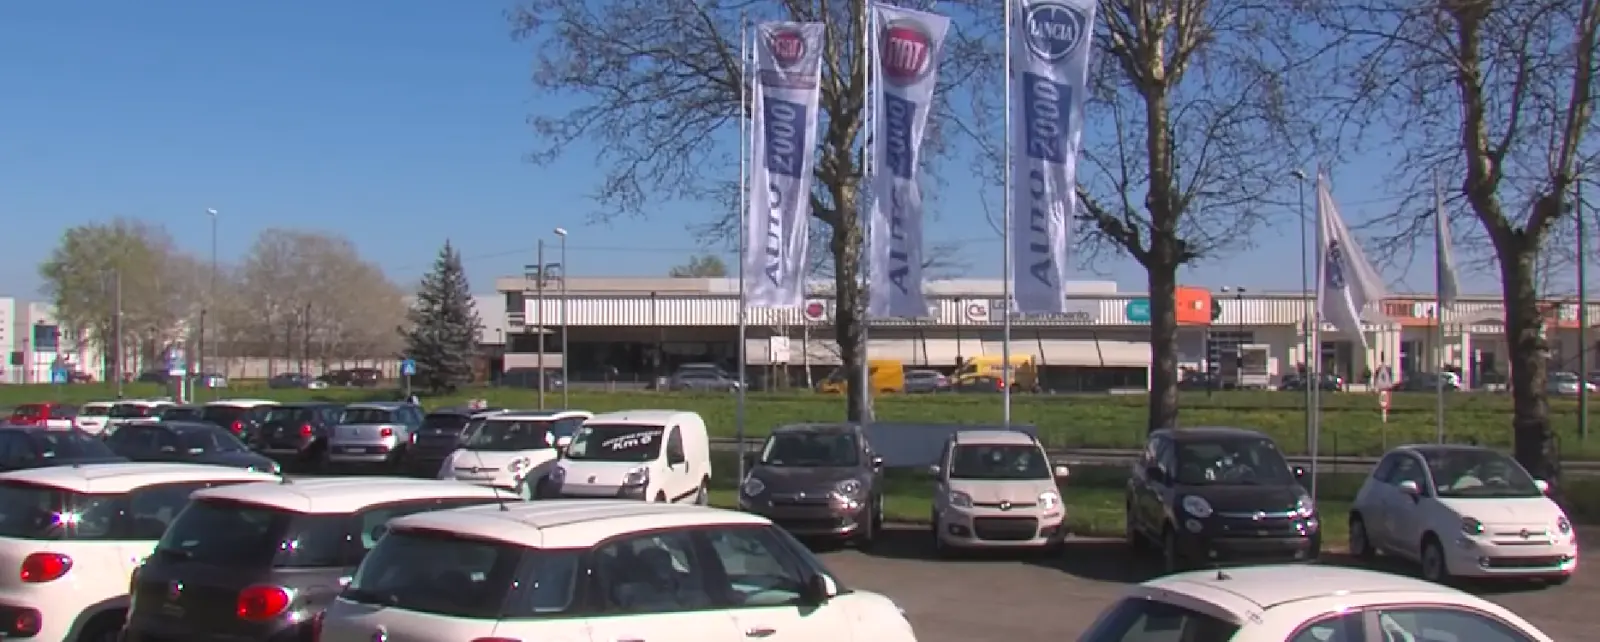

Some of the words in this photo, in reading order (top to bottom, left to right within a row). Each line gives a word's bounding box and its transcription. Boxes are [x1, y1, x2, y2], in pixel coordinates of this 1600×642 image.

[888, 36, 925, 70] FIAT
[1030, 19, 1074, 41] LANCIA
[770, 104, 796, 174] 2000
[1030, 80, 1060, 158] 2000
[765, 182, 782, 288] AUTO
[1029, 169, 1052, 288] AUTO
[612, 439, 639, 451] Km
